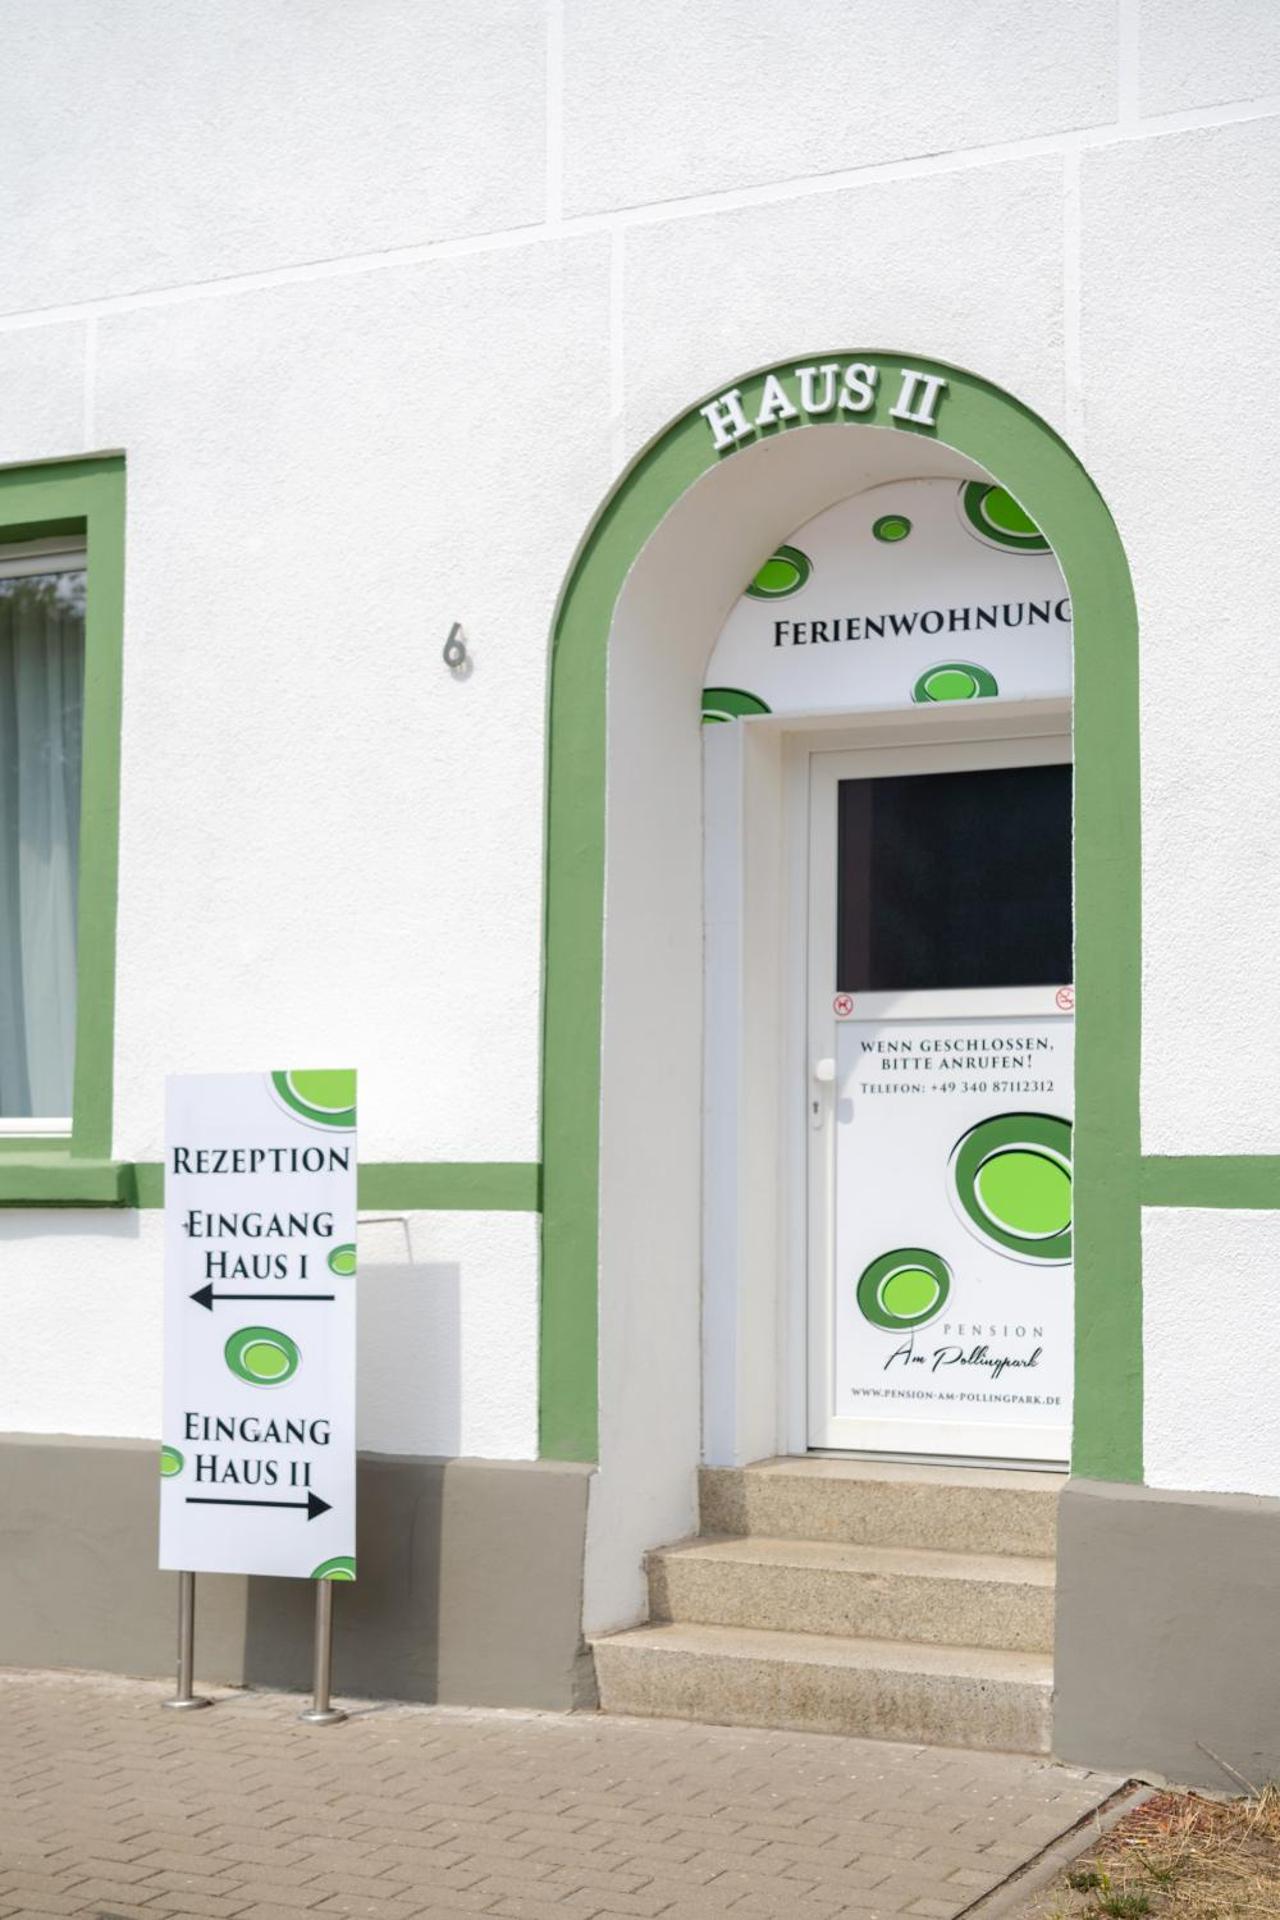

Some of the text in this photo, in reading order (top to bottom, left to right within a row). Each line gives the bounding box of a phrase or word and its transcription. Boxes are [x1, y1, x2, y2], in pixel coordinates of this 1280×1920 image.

[701, 363, 948, 450] HAUS II
[443, 622, 466, 668] 6
[861, 1038, 1054, 1052] WENN GESCHLOSSEN,
[882, 1054, 1033, 1070] BITTE ANRUFEN!
[861, 1080, 1054, 1094] TELEFON: +49 340 87112312
[173, 1146, 350, 1174] REZEPTION
[187, 1210, 334, 1238] EINGANG
[205, 1251, 310, 1280] HAUS I
[943, 1324, 1044, 1337] PENSION
[883, 1325, 1043, 1379] Am Pollingpark
[184, 1412, 330, 1446] EINGANG
[196, 1454, 312, 1487] HAUS II
